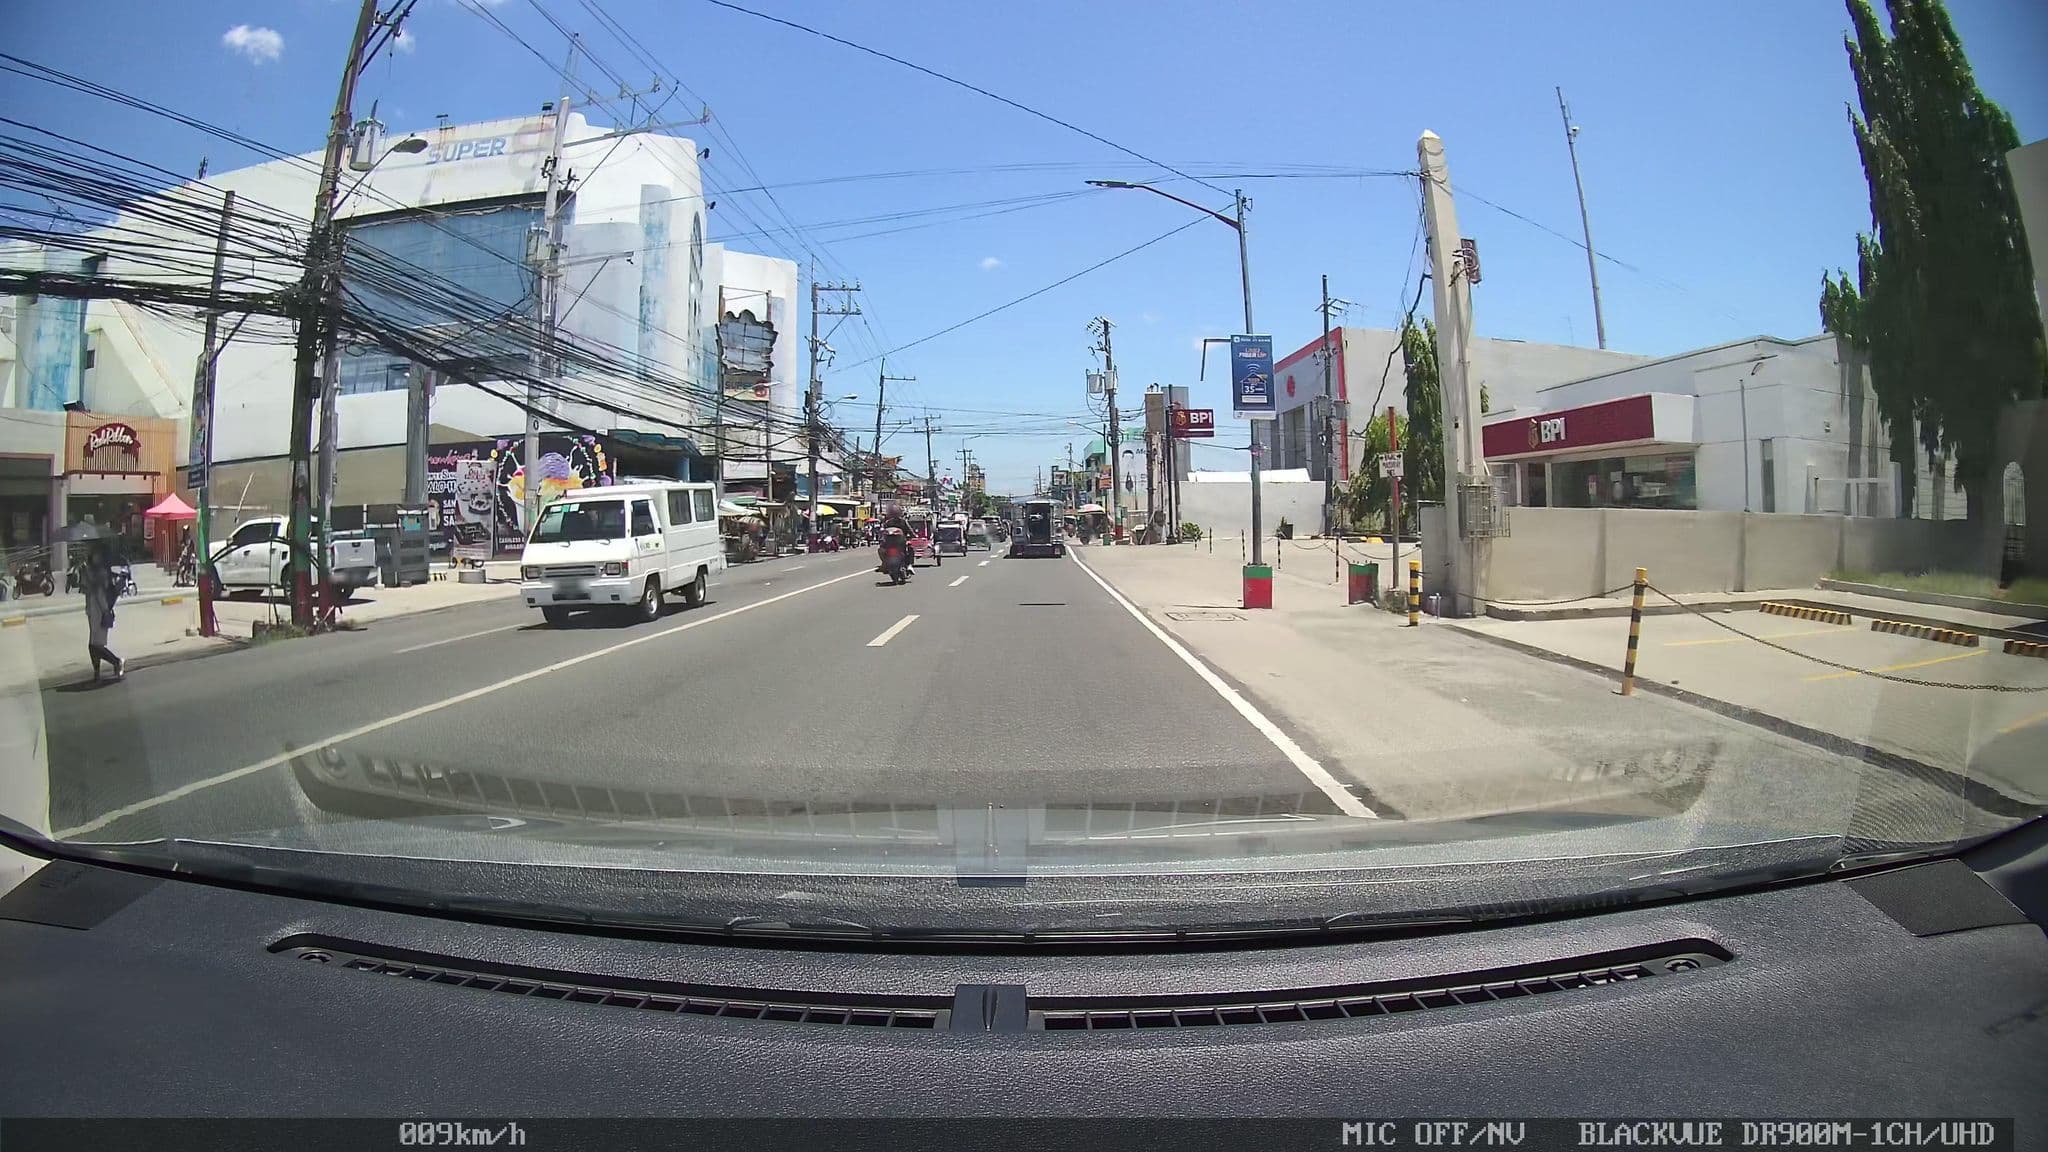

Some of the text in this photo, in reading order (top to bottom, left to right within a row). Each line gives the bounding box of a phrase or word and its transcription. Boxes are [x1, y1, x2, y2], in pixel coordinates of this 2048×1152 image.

[428, 137, 506, 162] SUPER
[1190, 412, 1213, 424] BPI
[1541, 417, 1565, 442] BPI
